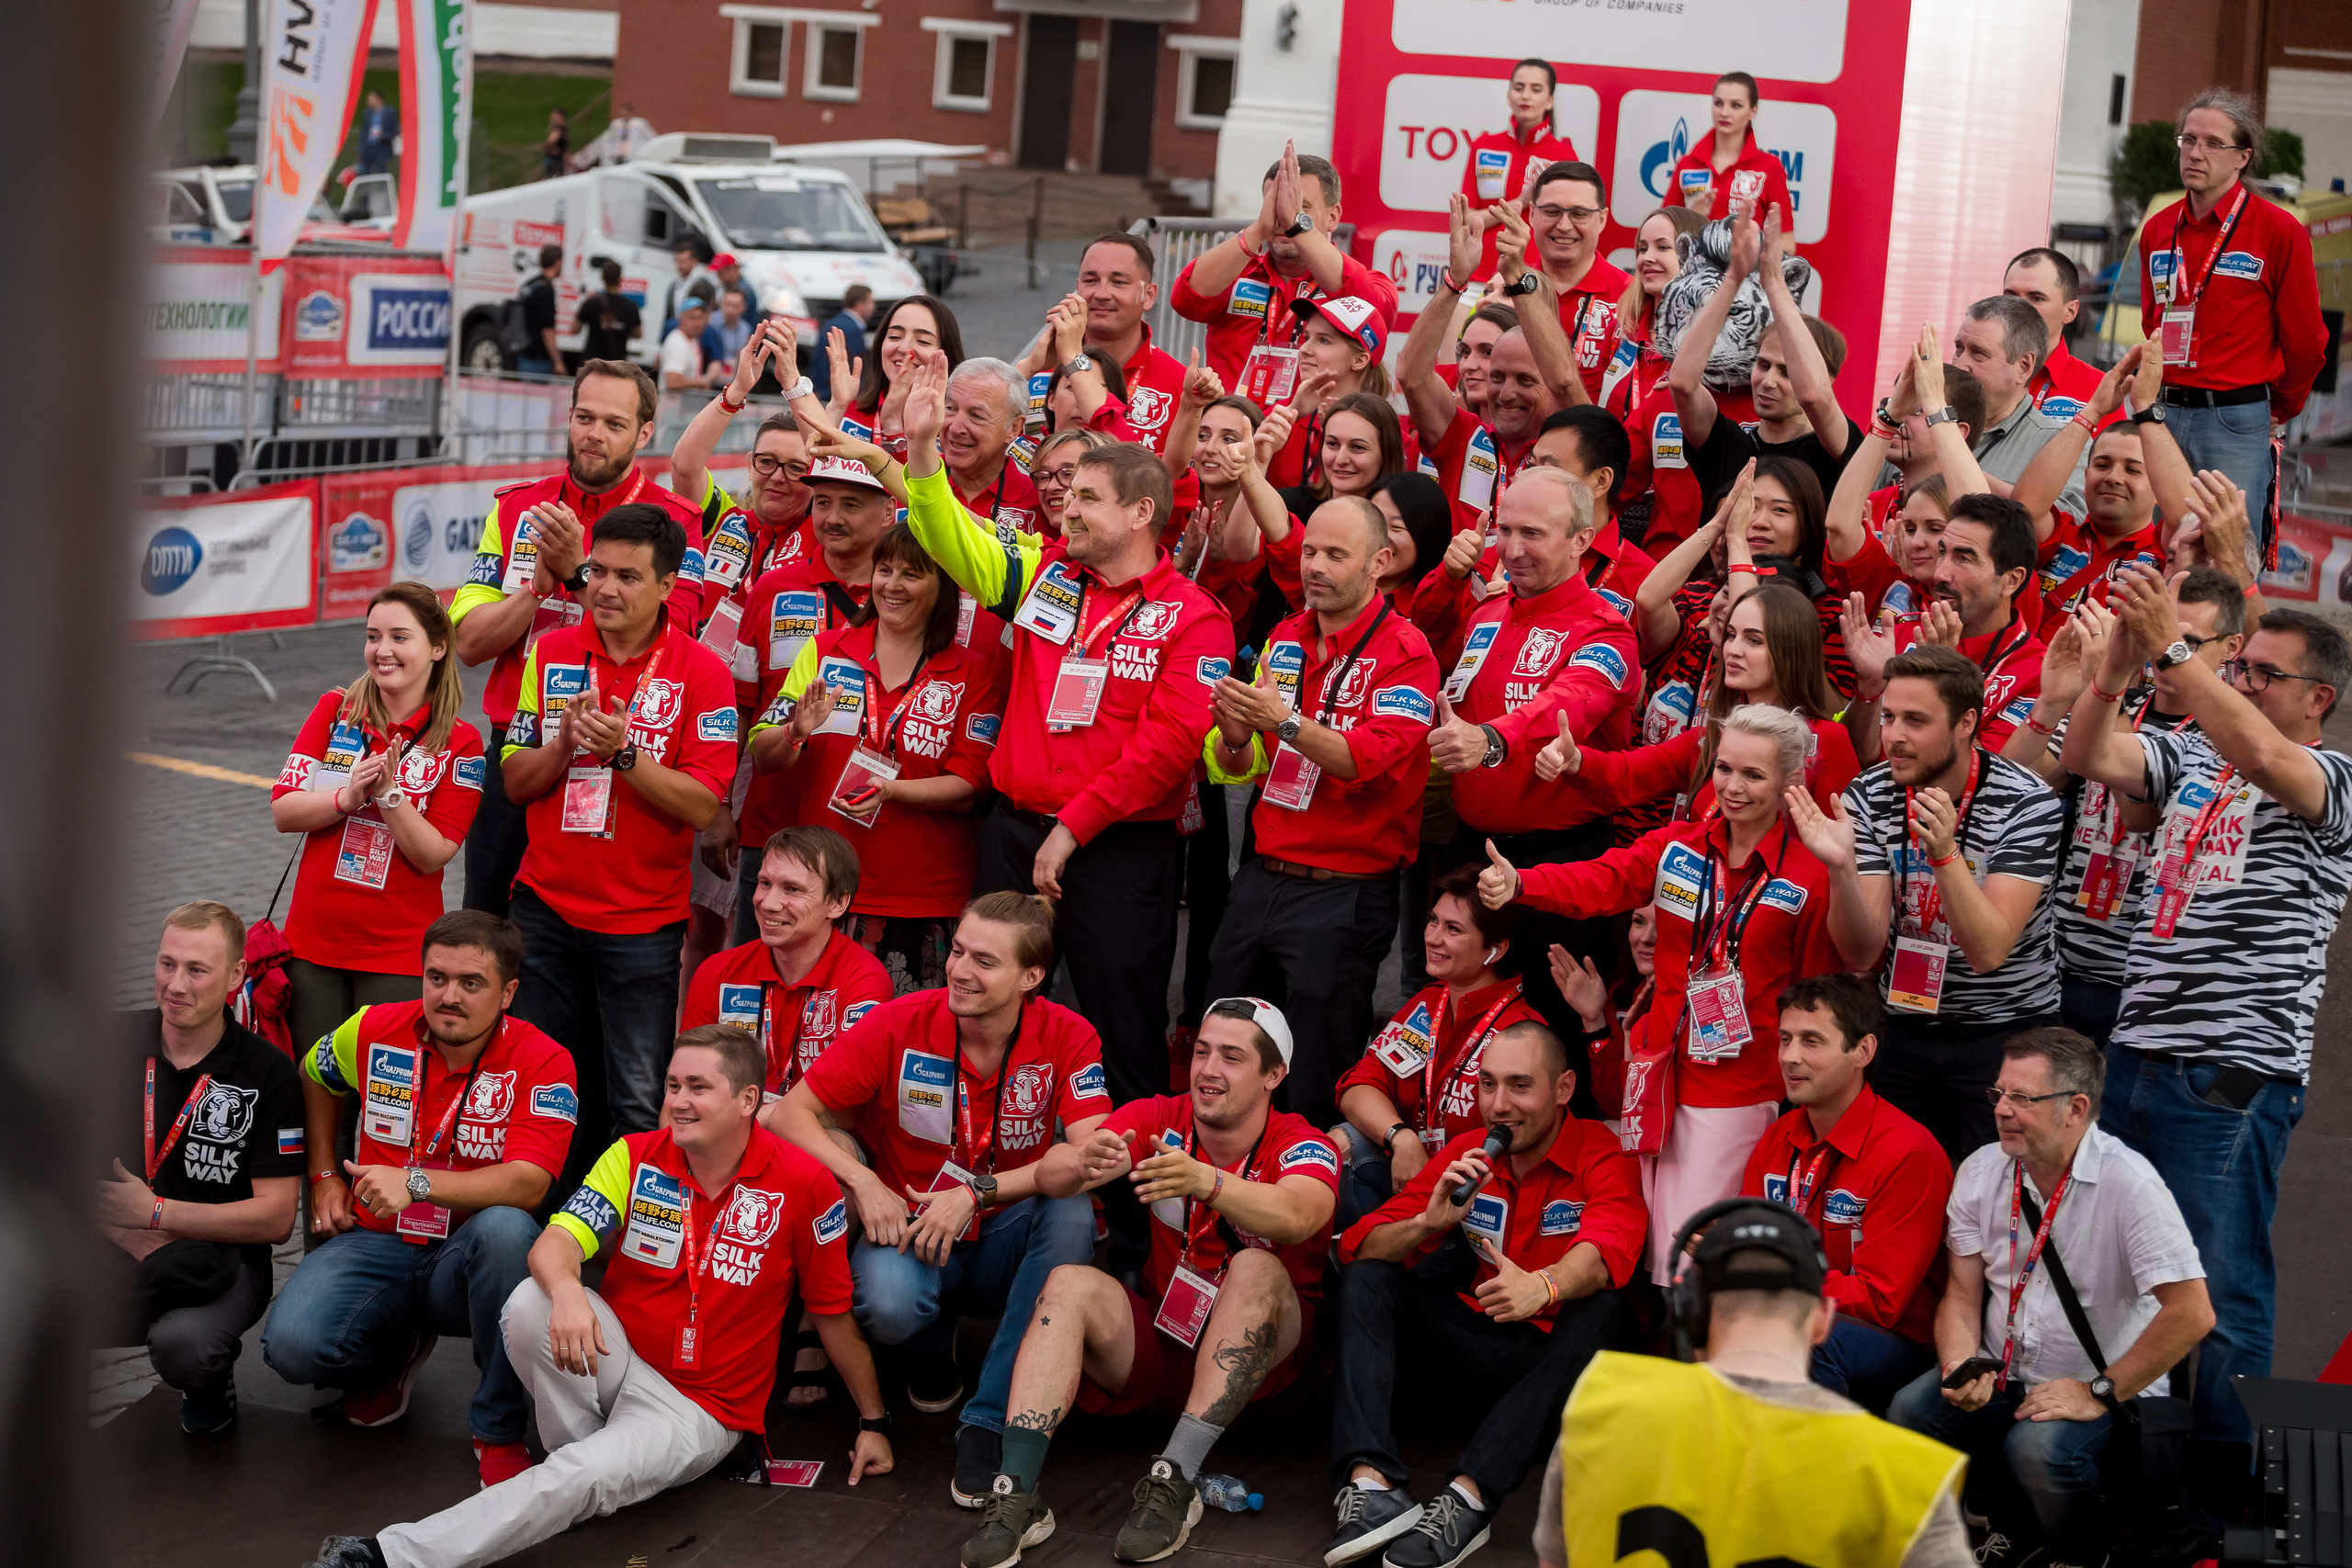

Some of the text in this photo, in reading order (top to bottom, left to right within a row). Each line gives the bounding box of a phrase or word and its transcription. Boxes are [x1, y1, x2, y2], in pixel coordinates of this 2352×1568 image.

[2218, 258, 2259, 270] SILK WAY
[377, 300, 452, 338] РОССИ
[514, 543, 537, 554] 越野
[789, 603, 815, 612] GAZPROM
[1035, 591, 1078, 615] FBLIFE.COM
[775, 629, 814, 638] FBLIFE.COM
[1113, 644, 1160, 665] SILK
[1577, 649, 1625, 674] SILK WAY
[1112, 660, 1158, 682] WAY
[1204, 663, 1226, 677] SILK
[836, 675, 865, 688] GAZPROM
[547, 699, 568, 710] 越野
[1379, 694, 1430, 711] SILK WAY
[1054, 710, 1089, 719] Organisation
[706, 718, 731, 727] SILK
[903, 719, 952, 746] SILK
[902, 734, 947, 760] WAY
[321, 762, 350, 773] LIFE.COM
[368, 854, 387, 863] WAY
[369, 847, 387, 857] SILK
[1659, 890, 1694, 909] FBLIFE.COM
[1774, 886, 1800, 900] WAY
[1909, 942, 1934, 952] 27.07.2018
[1722, 1003, 1740, 1014] SILK
[1724, 1009, 1742, 1020] WAY
[1724, 1015, 1744, 1025] RALLY
[1726, 1021, 1746, 1032] 2018
[385, 1064, 413, 1078] GAZPROM
[922, 1070, 945, 1080] GAZPROM
[1078, 1076, 1101, 1086] SILK
[369, 1081, 412, 1101] 越野e族
[369, 1093, 410, 1110] FBLIFE.COM
[537, 1094, 565, 1104] SILK
[908, 1096, 942, 1109] FBLIFE.COM
[1000, 1115, 1046, 1136] SILK
[457, 1123, 508, 1144] SILK
[1000, 1129, 1046, 1151] WAY
[185, 1142, 242, 1169] SILK
[457, 1140, 505, 1160] WAY
[184, 1159, 239, 1185] WAY
[577, 1186, 616, 1225] SILK
[634, 1201, 682, 1224] 越野e族
[403, 1218, 442, 1231] Organisation
[570, 1200, 607, 1234] WAY
[631, 1212, 680, 1234] FBLIFE.COM
[713, 1242, 765, 1270] SILK
[711, 1259, 760, 1286] WAY
[1161, 1314, 1193, 1338] Organisation
